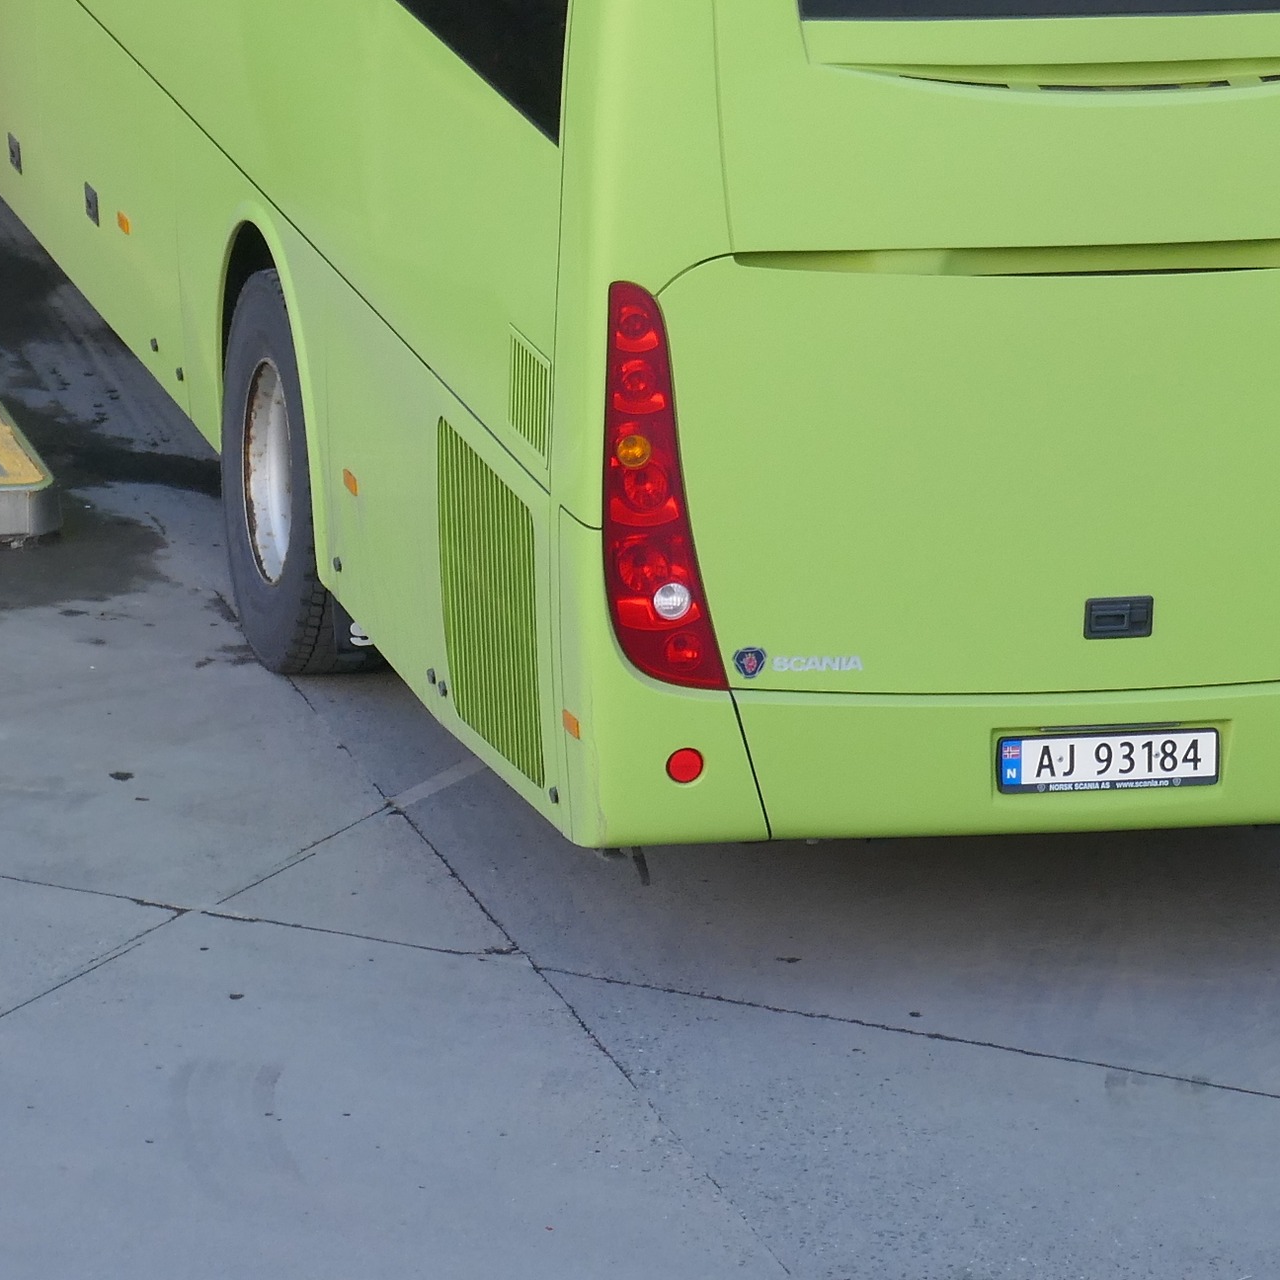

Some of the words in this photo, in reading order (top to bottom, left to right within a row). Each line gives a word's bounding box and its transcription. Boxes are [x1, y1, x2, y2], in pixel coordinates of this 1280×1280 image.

[772, 655, 863, 671] SCANIA
[1035, 743, 1076, 778] AJ
[1094, 738, 1202, 776] 93184
[1006, 768, 1017, 779] N
[1049, 783, 1073, 792] NORSK
[1074, 782, 1100, 791] SCANIA
[1100, 781, 1111, 790] AS
[1115, 778, 1170, 789] www.scania.no
